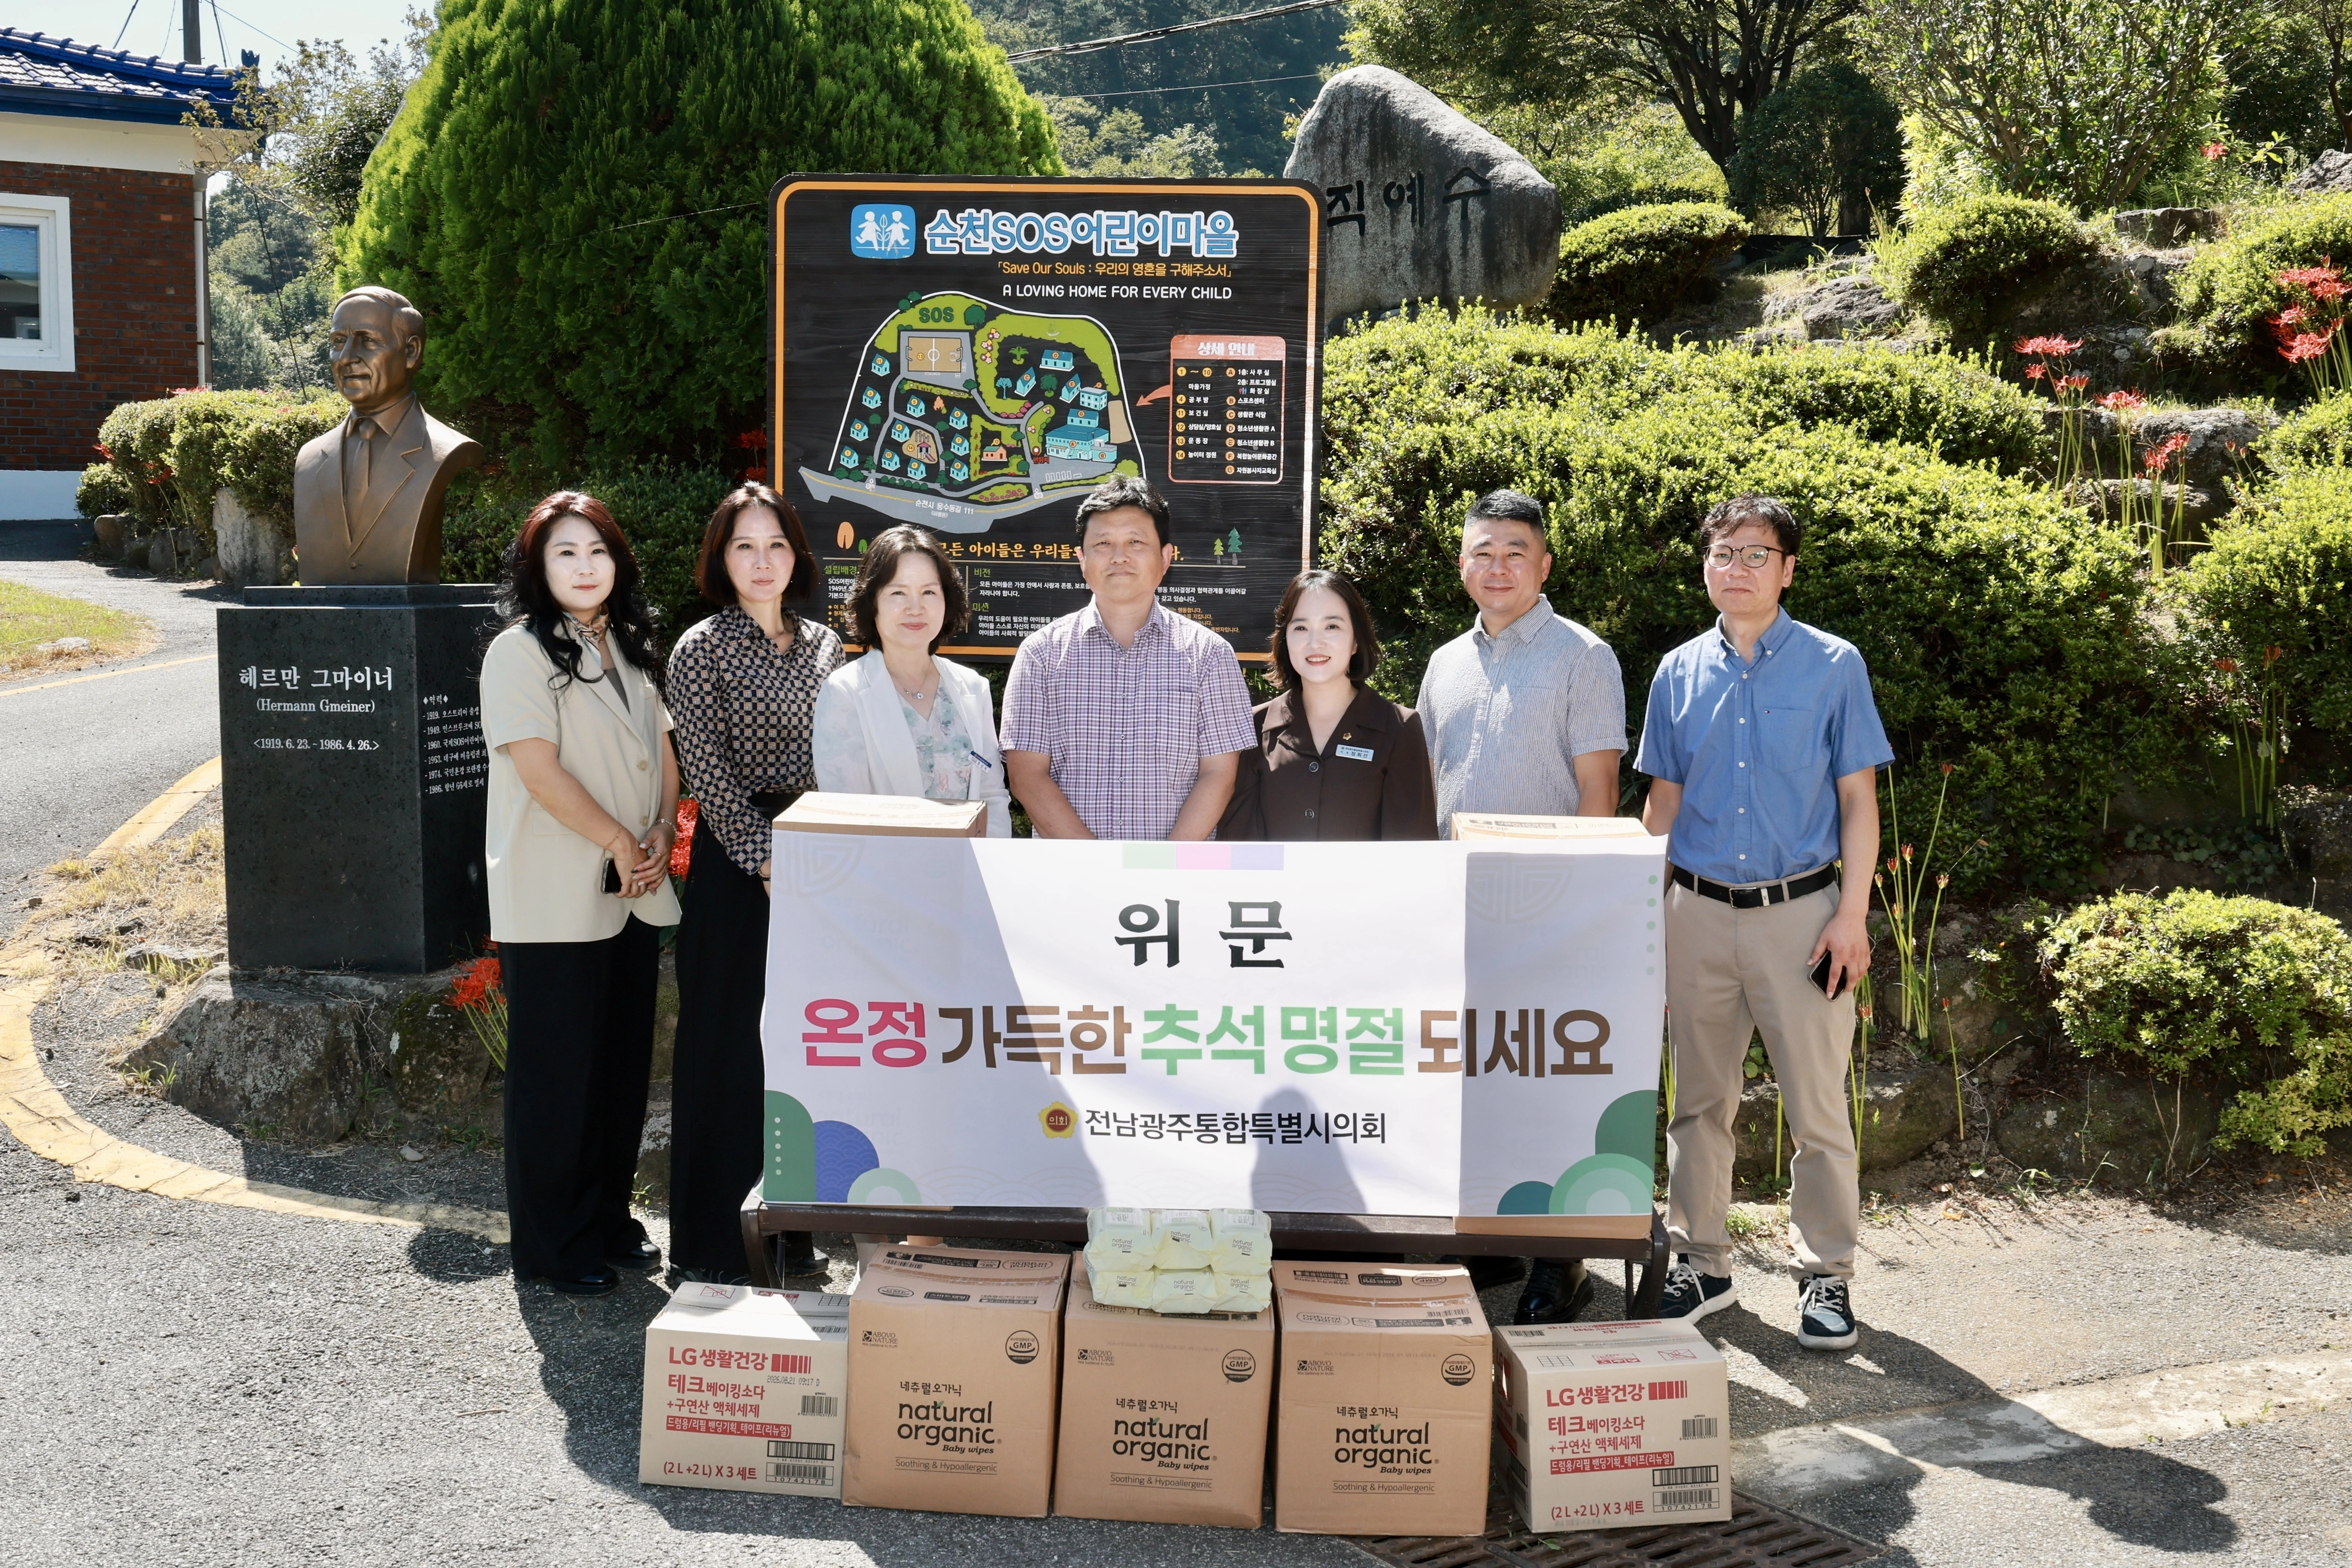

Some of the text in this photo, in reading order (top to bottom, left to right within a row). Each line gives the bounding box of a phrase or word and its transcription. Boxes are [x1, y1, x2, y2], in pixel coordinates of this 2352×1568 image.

[924, 208, 1239, 257] 순천SOS어린이마을
[1033, 262, 1051, 274] Our
[1055, 263, 1085, 275] Souls
[1095, 263, 1129, 276] 우리의
[1133, 264, 1167, 277] 영혼을
[1003, 285, 1232, 299] A LOVING HOME FOR EVERY CHILD
[919, 307, 954, 323] SOS
[1198, 342, 1255, 356] 상세 안내
[916, 500, 934, 509] 순천시
[937, 503, 961, 513] 용수동길
[969, 541, 1025, 557] 아이들은
[824, 566, 857, 575] 설립배경
[974, 568, 991, 578] 비전
[972, 602, 989, 612] 미션
[239, 666, 392, 691] 헤르만 그마이너
[256, 698, 375, 713] (Hermann Gmeiner)
[442, 706, 479, 718] 오스트리아 출생
[443, 721, 473, 733] 인스브루크에
[443, 753, 459, 763] 대구에
[443, 765, 465, 777] 국민훈장
[444, 778, 485, 792] 향년 66세로 별세
[802, 998, 927, 1068] 온정
[938, 1005, 1132, 1076] 가득한
[1418, 1008, 1613, 1078] 되세요
[1048, 1109, 1387, 1144] 의회 전남광주통합특별시의회
[669, 1346, 768, 1371] LG 생활건강
[668, 1374, 765, 1400] 테크 베이킹소다
[1546, 1383, 1645, 1407] LG 생활건강
[713, 1402, 760, 1418] 액체세제
[899, 1401, 993, 1423] natural
[667, 1417, 706, 1431] 드럼용/리필
[1115, 1417, 1208, 1440] natural
[1548, 1415, 1645, 1436] 테크 베이킹소다
[1336, 1422, 1429, 1445] natural
[942, 1445, 994, 1455] Baby wipes
[1595, 1435, 1642, 1453] 액체세제
[896, 1459, 997, 1473] Soothing Hypoallergenic
[1158, 1460, 1209, 1471] Baby wipes
[1380, 1466, 1404, 1475] Baby
[1551, 1458, 1590, 1472] 드럼용/리필
[727, 1466, 734, 1478] 3
[736, 1466, 757, 1480] 세트
[1111, 1474, 1212, 1489] Soothing Hypoallergenic
[1333, 1483, 1435, 1492] Soothing Hypoallergenic
[1615, 1502, 1621, 1514] 3
[1624, 1500, 1645, 1515] 세트
